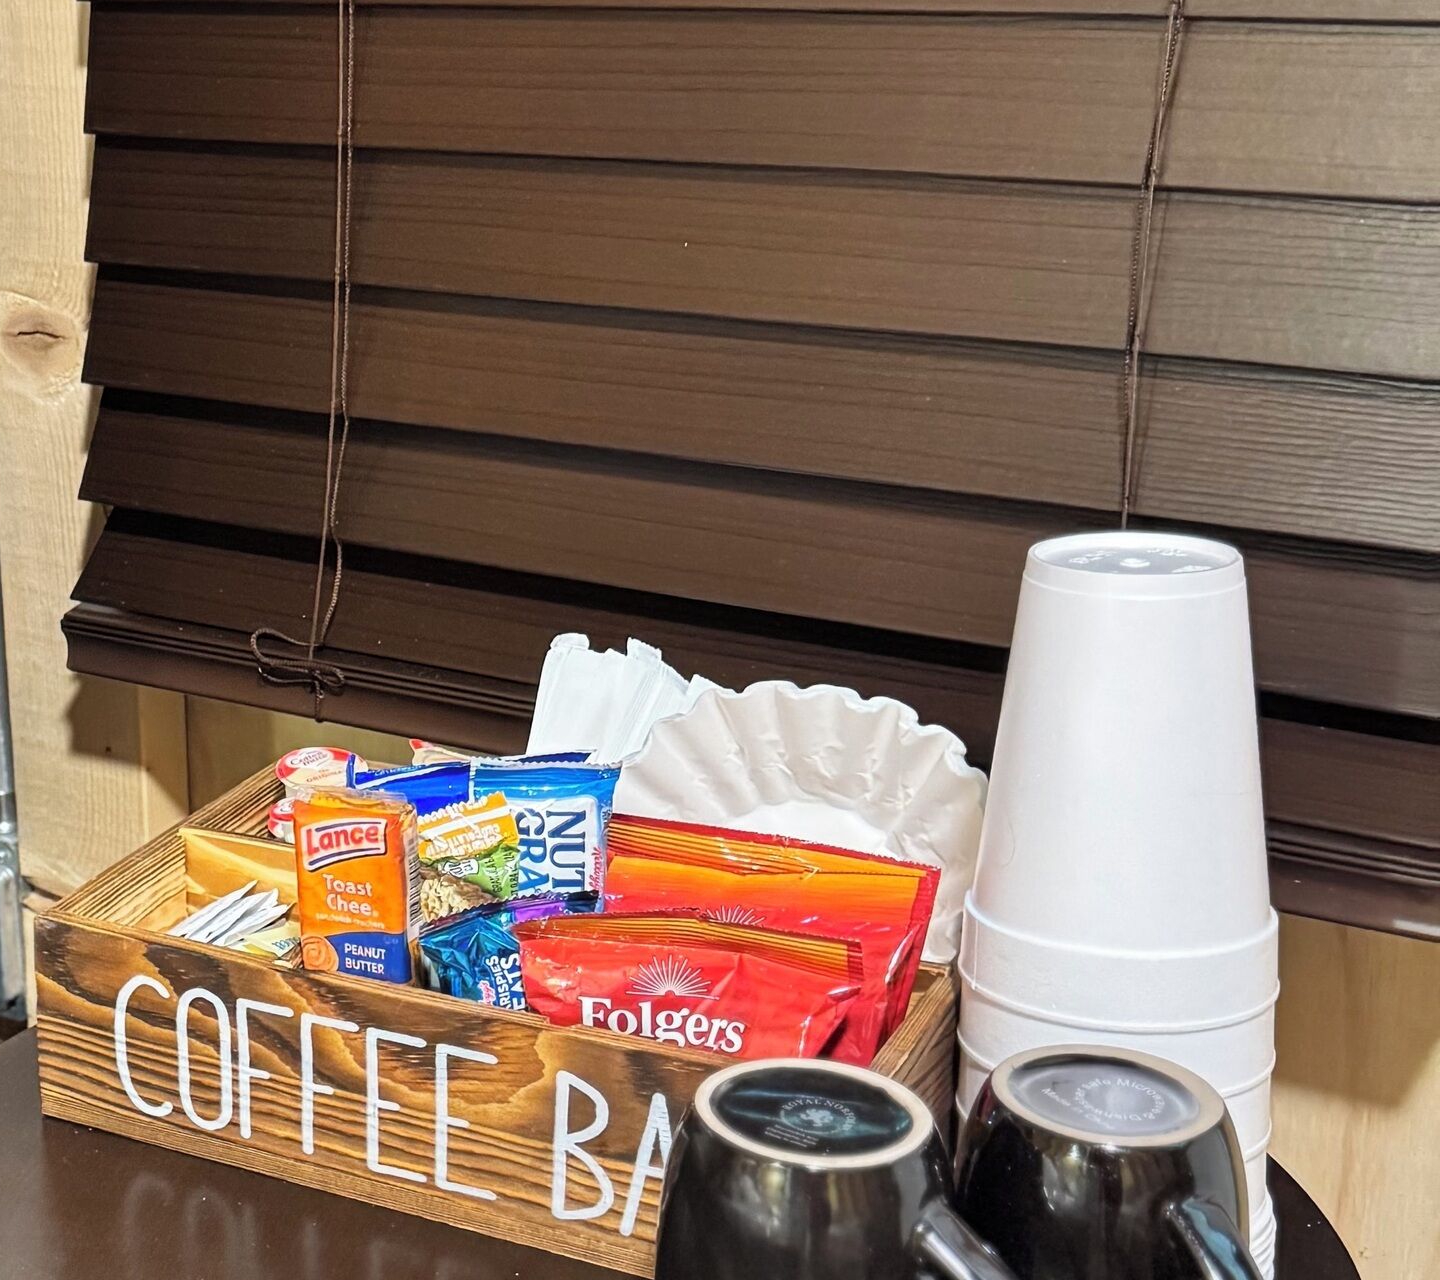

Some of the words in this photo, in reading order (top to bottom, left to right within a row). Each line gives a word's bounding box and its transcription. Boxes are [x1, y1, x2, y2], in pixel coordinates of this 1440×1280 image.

[306, 825, 379, 857] Lance
[515, 807, 550, 896] GRA
[545, 810, 587, 891] NUT
[323, 873, 373, 897] Toast
[344, 942, 386, 960] PEANUT
[345, 957, 385, 974] BUTTER
[500, 952, 526, 1011] EATS
[578, 995, 747, 1053] Folgers
[113, 973, 500, 1203] COFFEE
[551, 1069, 672, 1236] BA
[782, 1098, 822, 1111] ROYAL
